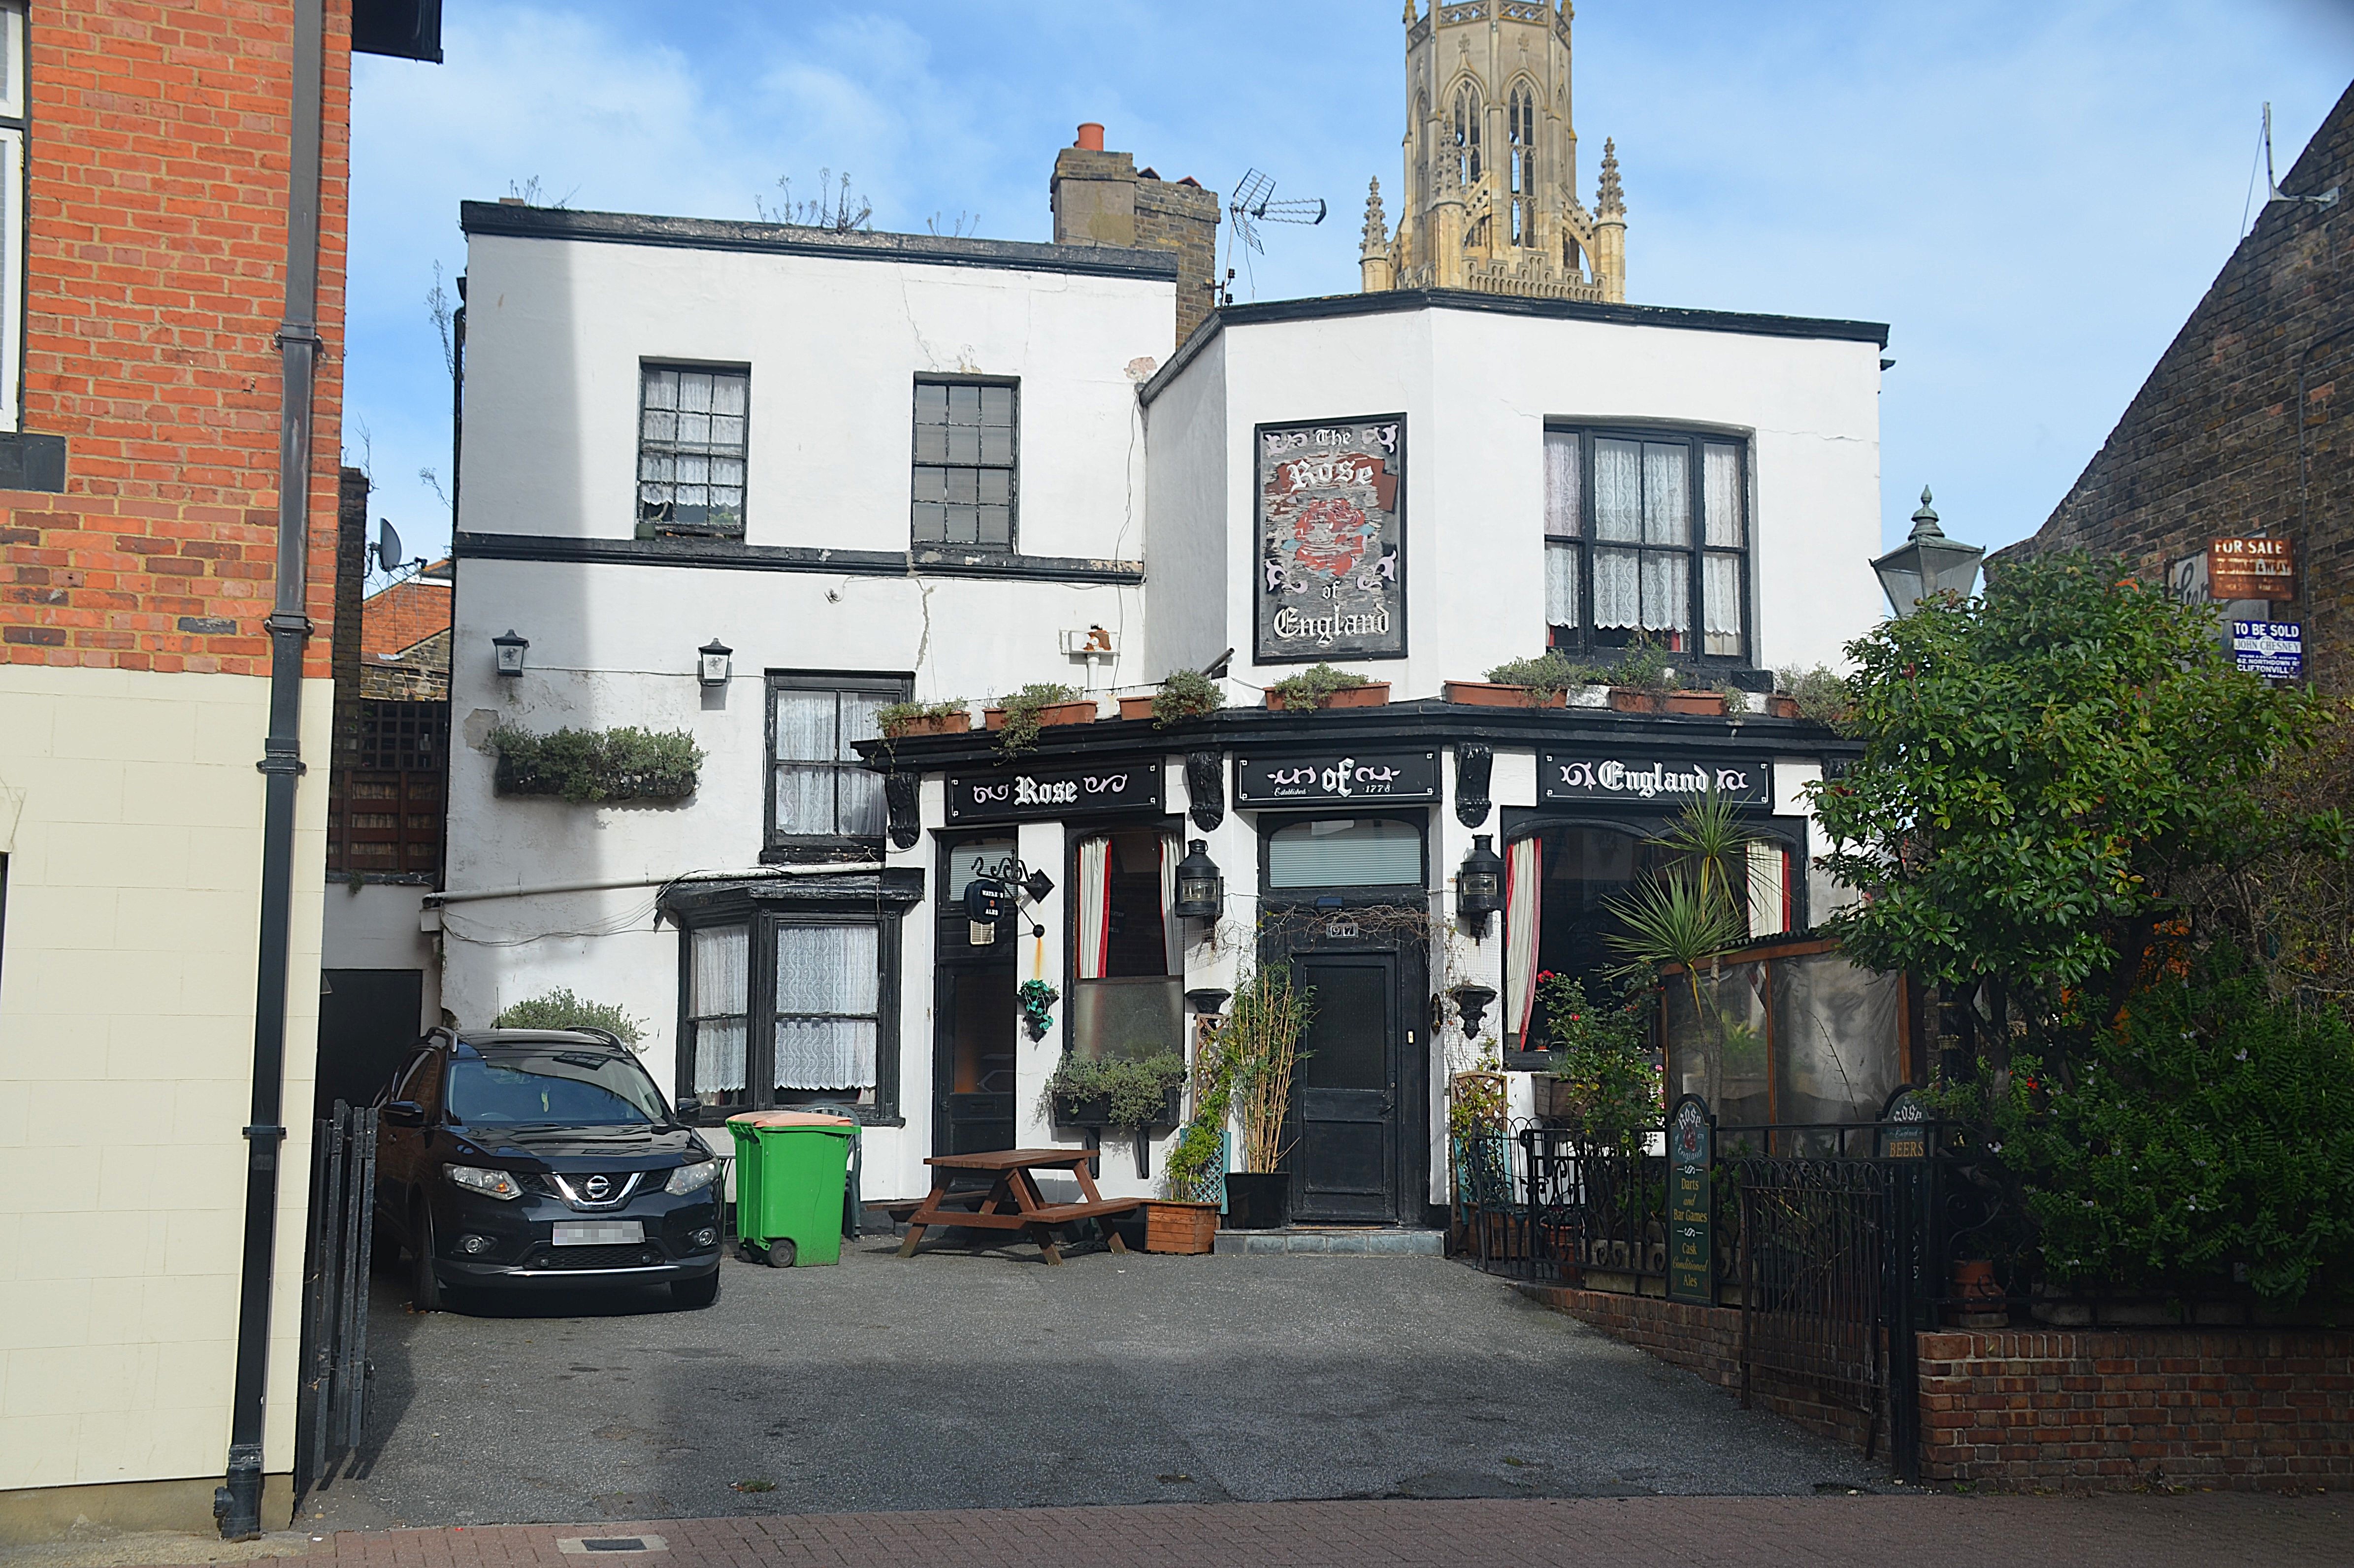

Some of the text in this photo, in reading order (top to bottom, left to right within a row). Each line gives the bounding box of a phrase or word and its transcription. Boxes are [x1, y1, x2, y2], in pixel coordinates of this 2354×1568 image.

[1316, 429, 1351, 446] The
[1286, 458, 1374, 493] Rose
[2215, 539, 2283, 555] FOR SALE
[1322, 581, 1341, 599] of
[1274, 604, 1390, 645] England
[2233, 622, 2299, 638] TO BE SOLD
[2236, 640, 2300, 652] JOHN CHESNEY
[1321, 756, 1355, 798] of
[1598, 759, 1709, 798] England
[1014, 776, 1079, 806] Rose
[1274, 787, 1308, 796] Established
[1365, 784, 1392, 793] 1778
[1332, 926, 1354, 936] 97
[1678, 1107, 1701, 1130] Rose
[1678, 1144, 1702, 1163] England
[1889, 1142, 1923, 1157] BEERS
[1681, 1178, 1700, 1191] Darts
[1683, 1194, 1696, 1206] and
[1673, 1209, 1708, 1223] Bar Games
[1682, 1242, 1697, 1255] Cask
[1672, 1256, 1708, 1272] Conditioned
[1683, 1274, 1698, 1287] Ales
